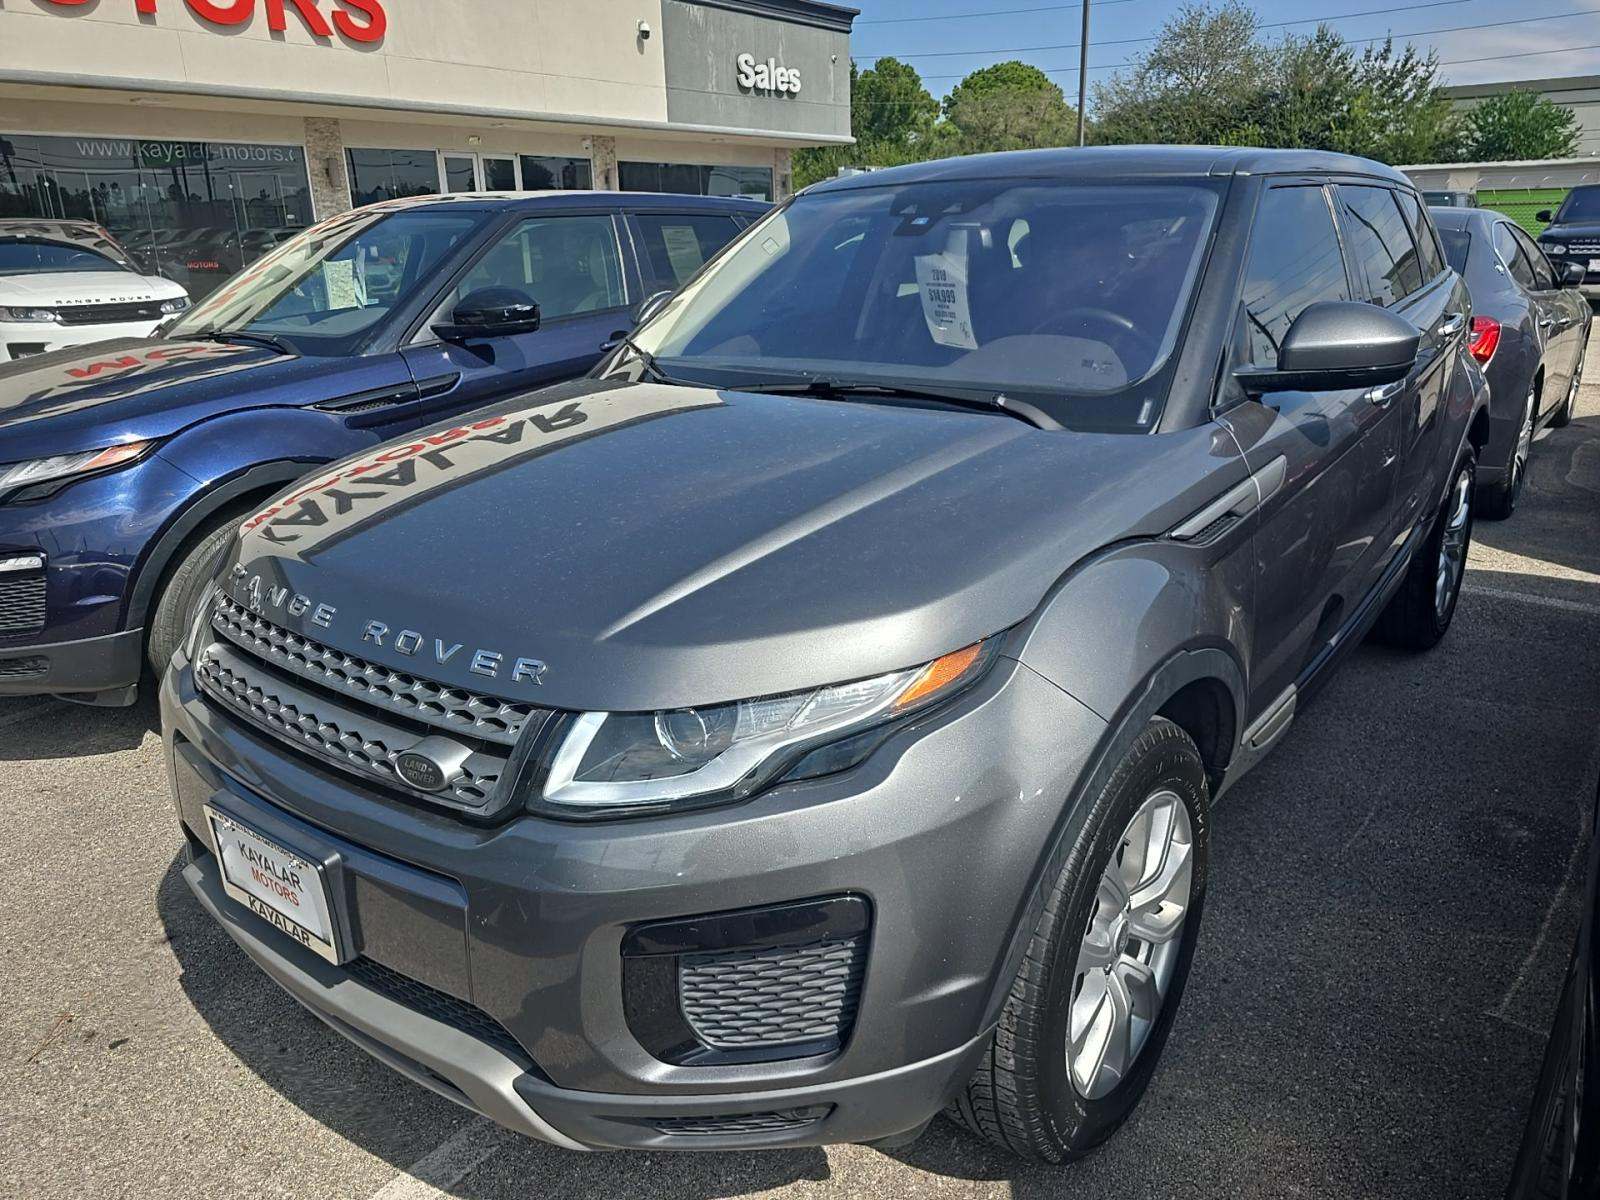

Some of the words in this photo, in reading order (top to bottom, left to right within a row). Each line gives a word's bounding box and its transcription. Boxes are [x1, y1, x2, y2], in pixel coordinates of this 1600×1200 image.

[736, 53, 802, 94] Sales
[228, 562, 338, 628] RANGE
[360, 618, 549, 686] ROVER
[237, 840, 304, 893] KAYALAR
[251, 867, 300, 907] MOTORS
[248, 895, 312, 947] KAYALAR
